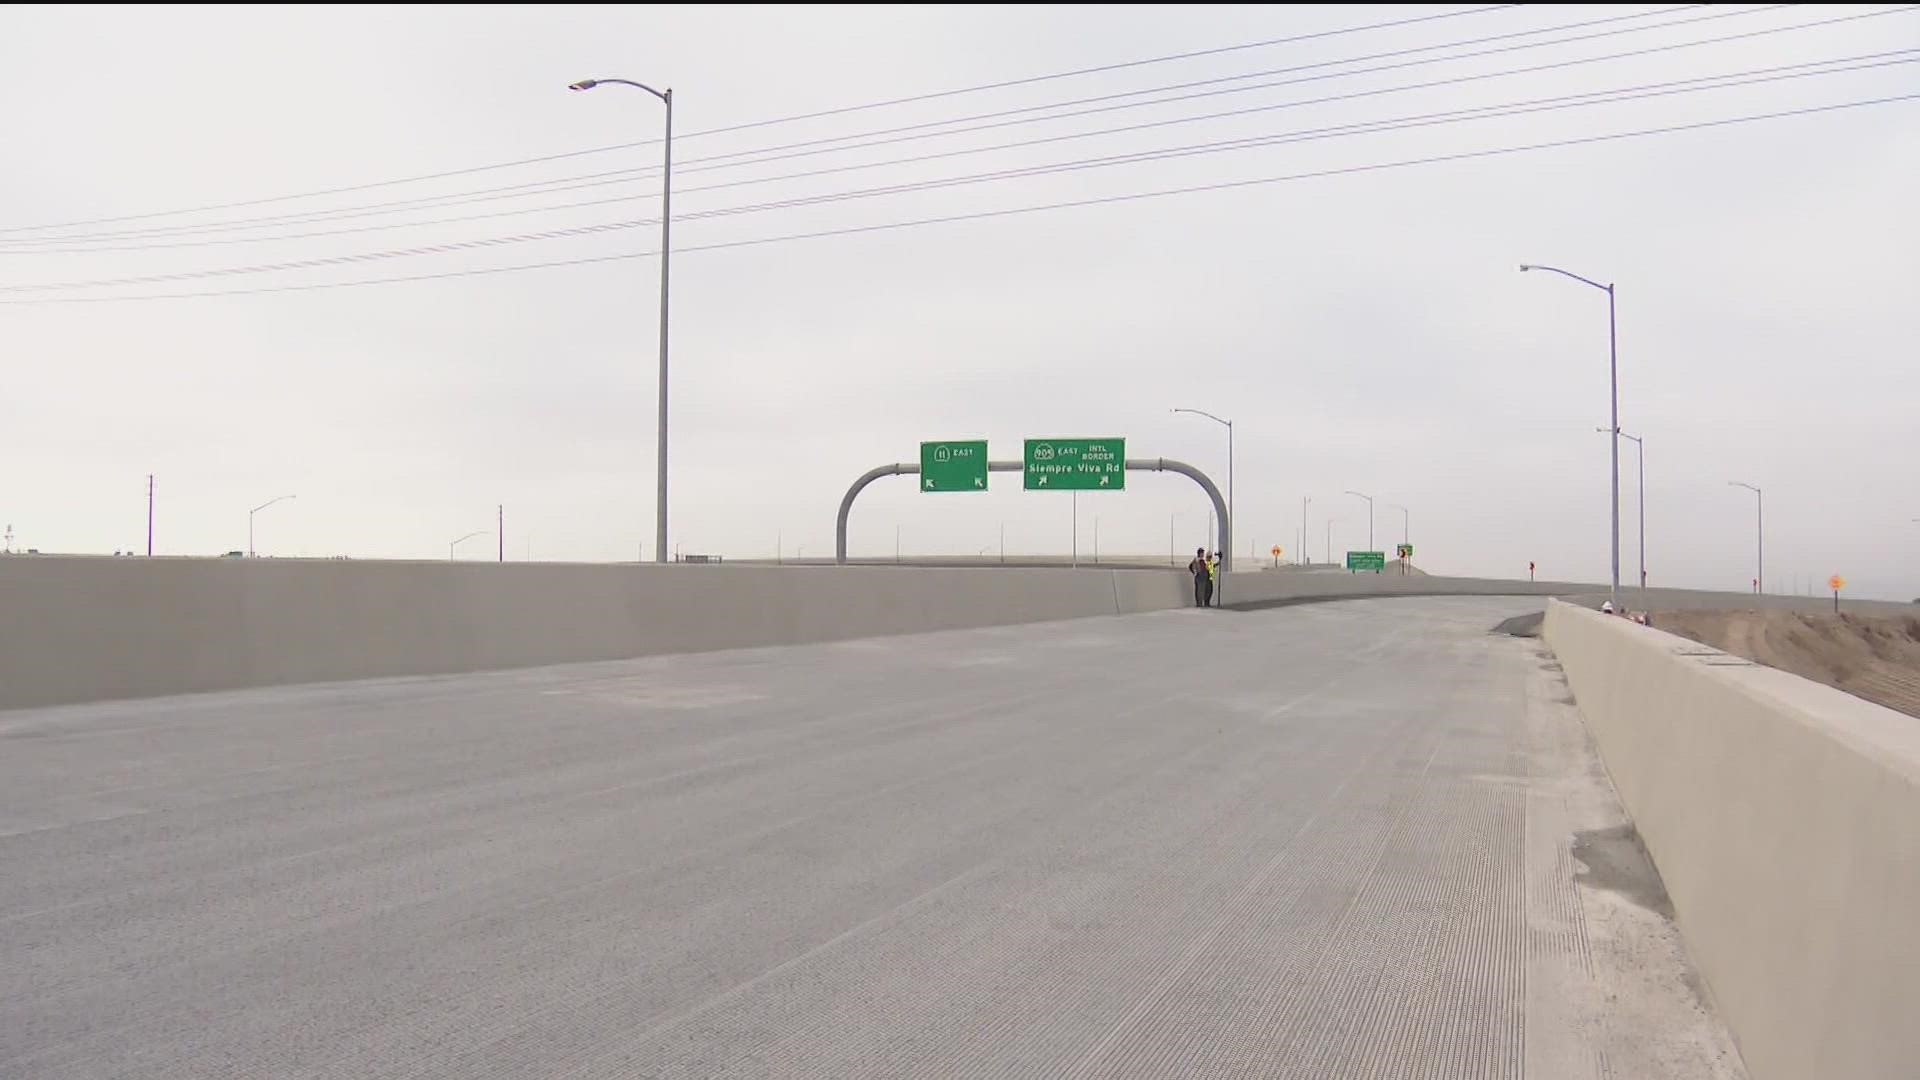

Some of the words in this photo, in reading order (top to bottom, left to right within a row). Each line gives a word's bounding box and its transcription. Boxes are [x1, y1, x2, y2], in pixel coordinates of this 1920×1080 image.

[939, 450, 945, 459] 11
[953, 448, 973, 456] EAST
[1036, 449, 1052, 457] 905
[1057, 447, 1078, 456] EAST
[1029, 463, 1072, 474] Siempre
[1077, 463, 1101, 473] Viva
[1106, 463, 1120, 472] Rd
